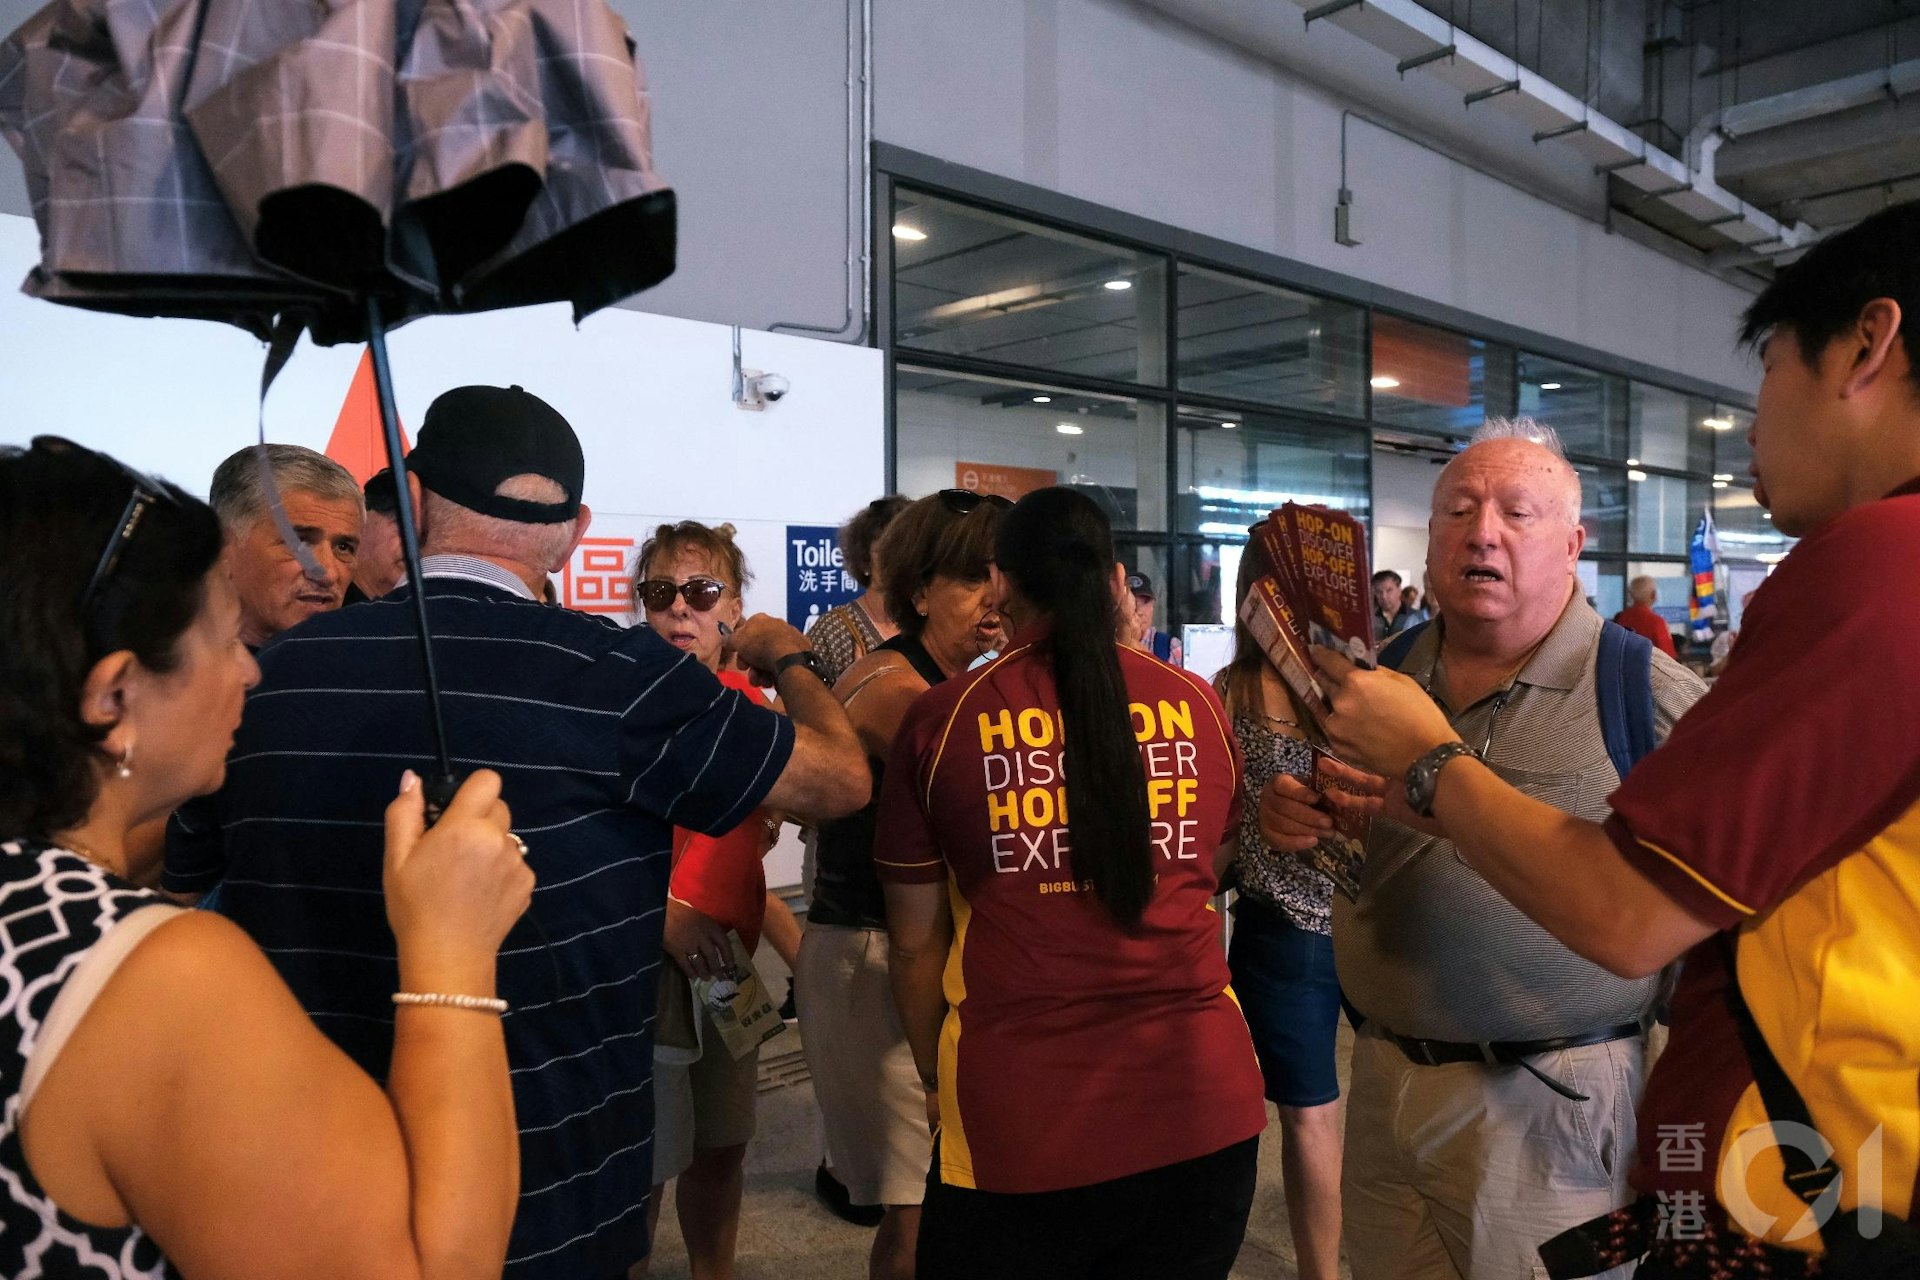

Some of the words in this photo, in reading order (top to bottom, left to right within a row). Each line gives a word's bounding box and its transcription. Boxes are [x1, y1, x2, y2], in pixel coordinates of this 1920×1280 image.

[1295, 510, 1353, 545] HOP-ON
[1298, 528, 1354, 561] DISCOVER
[792, 539, 845, 567] Toile
[1301, 544, 1356, 578] HOP-OFF
[799, 569, 858, 593] 洗手間
[1303, 560, 1359, 597] EXPLORE
[978, 700, 1195, 752] HOON
[984, 741, 1198, 791] DISER
[987, 779, 1198, 832] HOFF
